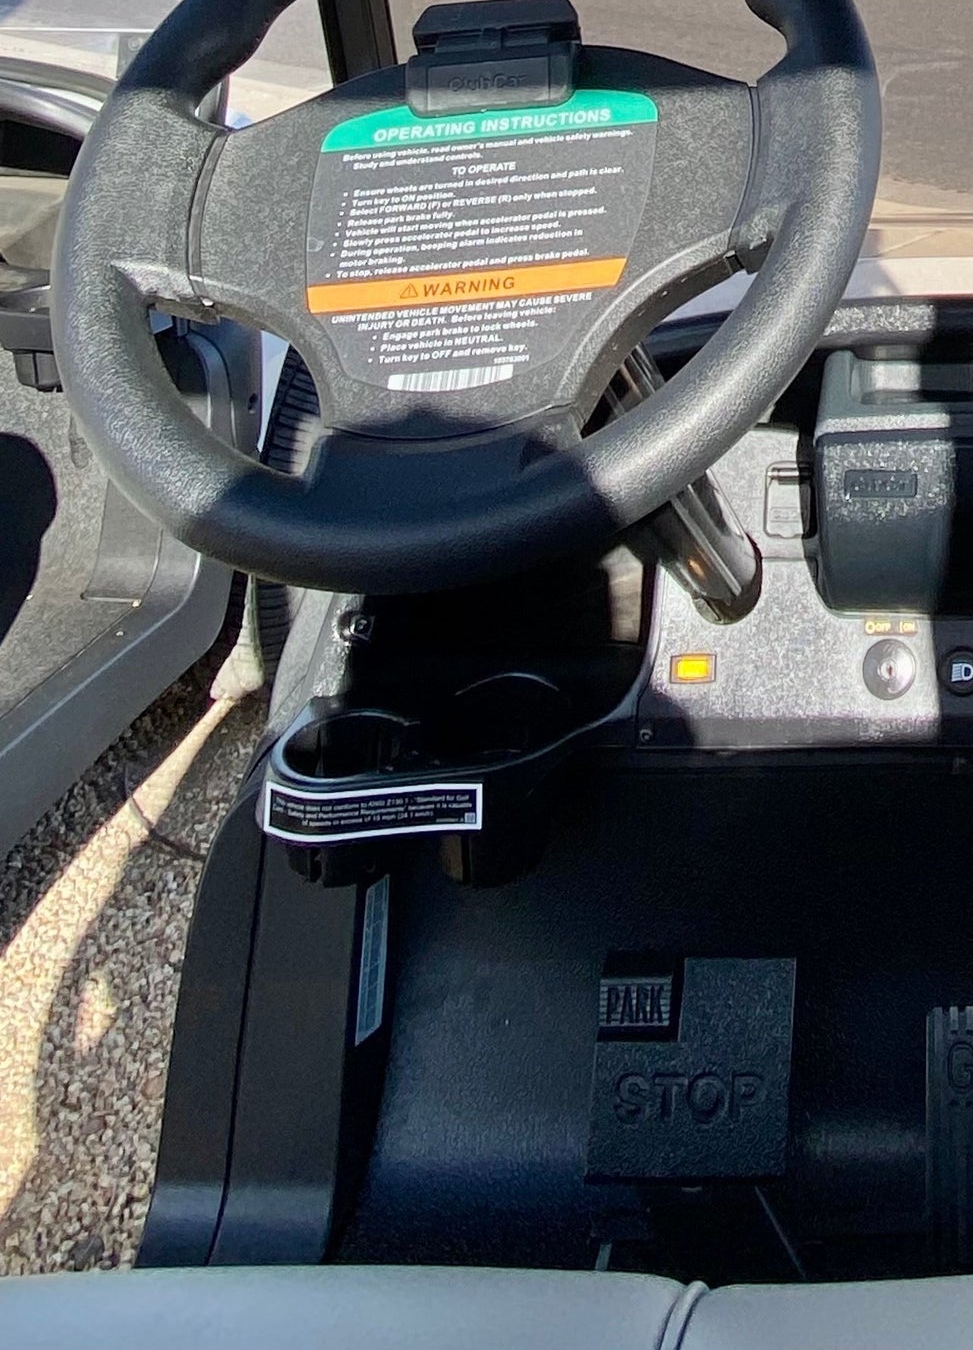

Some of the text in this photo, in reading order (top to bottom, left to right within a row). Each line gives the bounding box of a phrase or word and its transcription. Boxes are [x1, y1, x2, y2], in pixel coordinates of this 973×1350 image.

[449, 73, 526, 91] Club Car
[373, 108, 612, 143] OPERATING INSTRUCTIONS
[517, 137, 533, 145] and
[378, 159, 395, 167] and
[451, 162, 516, 175] TO OPERATE
[434, 180, 463, 189] turned
[509, 173, 548, 182] direction
[550, 170, 567, 179] and
[567, 169, 588, 178] path
[350, 207, 378, 216] Select
[378, 203, 426, 213] FORWARD
[452, 196, 496, 206] REVERSE
[512, 193, 532, 202] only
[352, 198, 372, 206] Turn
[400, 194, 415, 202] ON
[345, 228, 378, 237] Vehicle
[380, 226, 396, 234] will
[397, 224, 419, 232] start
[420, 221, 453, 231] moving
[454, 218, 478, 227] when
[480, 214, 530, 224] accelerator
[531, 211, 557, 221] pedal
[347, 217, 383, 226] Release
[383, 215, 404, 224] park
[340, 248, 371, 258] During
[485, 234, 527, 244] indicates
[528, 230, 572, 240] reduction
[342, 238, 373, 248] Slowly
[374, 237, 400, 245] press
[400, 231, 452, 242] accelerator
[454, 228, 479, 238] pedal
[480, 227, 489, 235] to
[491, 224, 529, 233] increase
[339, 259, 367, 267] motor
[374, 265, 408, 274] release
[409, 260, 461, 271] accelerator
[461, 257, 488, 267] pedal
[489, 256, 506, 264] and
[507, 255, 531, 263] press
[534, 251, 560, 260] brake
[423, 276, 515, 296] WARNING
[331, 292, 592, 323] UNINTENDED VEHICLE MOVEMENT MAY CAUSE SEVERE
[357, 321, 394, 331] INJURY
[394, 319, 411, 327] OR
[451, 313, 483, 322] Before
[483, 310, 518, 320] leaving
[382, 330, 418, 341] Engage
[419, 328, 440, 338] park
[441, 325, 469, 334] brake
[470, 324, 479, 332] to
[481, 322, 500, 331] lock
[380, 334, 503, 352] Place vehicle in NEUTRAL.
[378, 354, 400, 363] Turn
[401, 352, 418, 362] key
[420, 351, 430, 360] to
[431, 349, 451, 358] OFF
[452, 348, 470, 357] and
[471, 346, 507, 355] remove
[606, 984, 664, 1024] PARK
[612, 1071, 766, 1126] STOP
